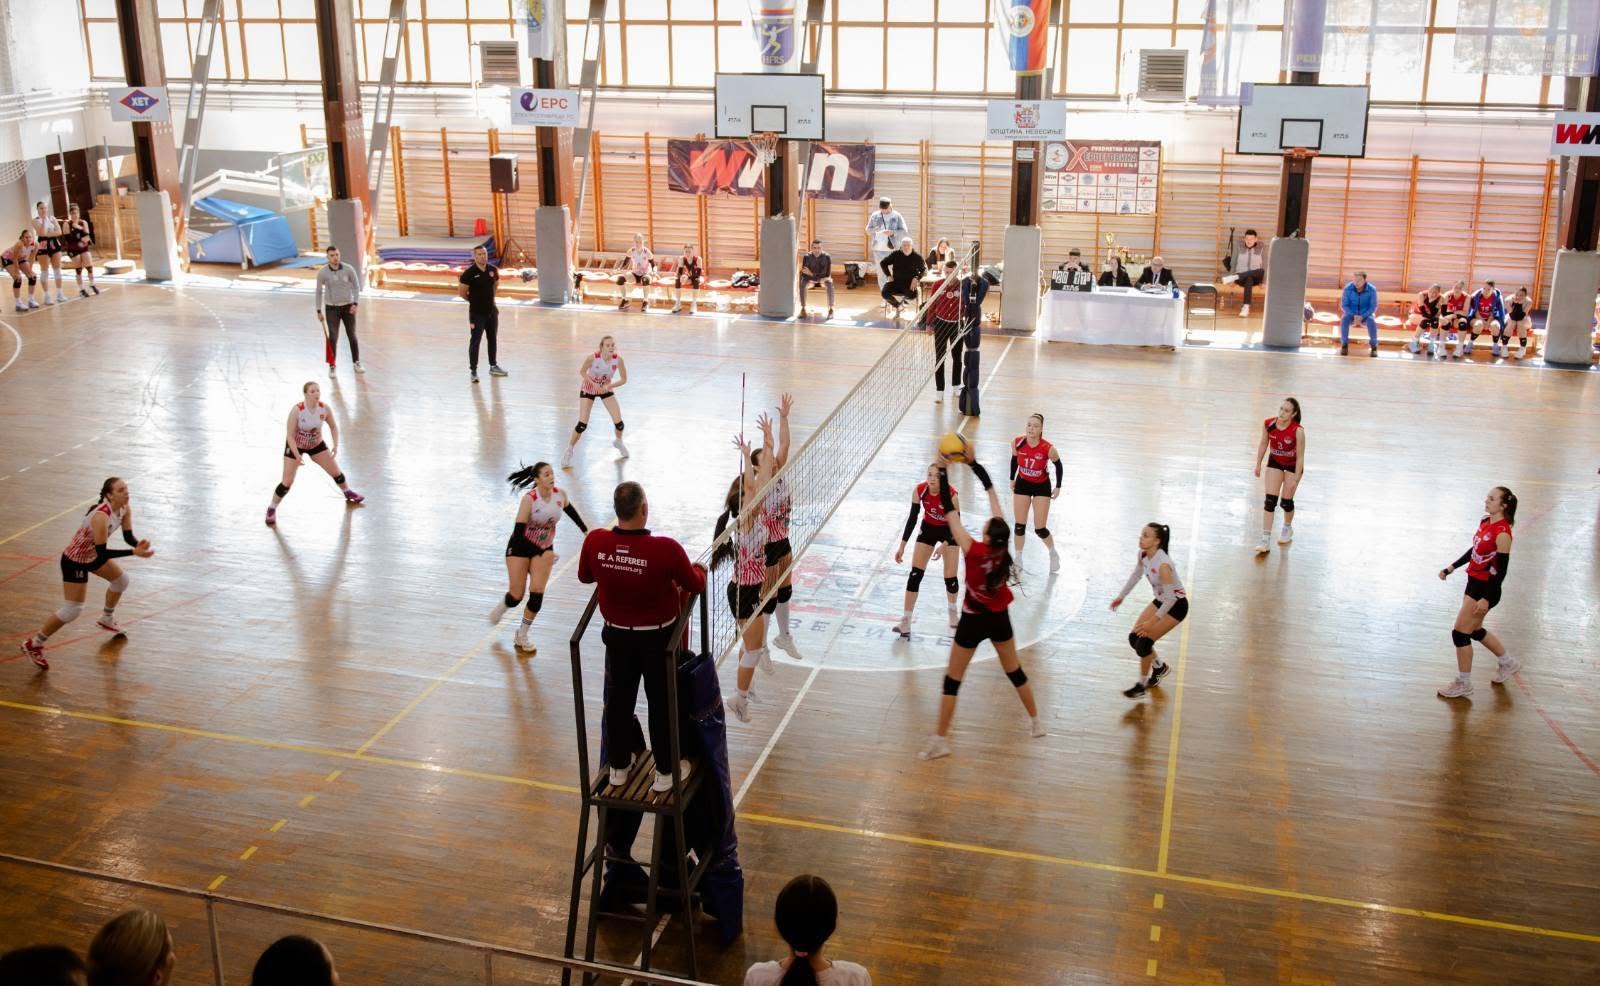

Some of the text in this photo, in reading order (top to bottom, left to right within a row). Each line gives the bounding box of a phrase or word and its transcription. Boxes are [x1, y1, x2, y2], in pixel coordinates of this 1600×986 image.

[1025, 128, 1064, 136] НЕВЕСИЊЕ
[1024, 458, 1036, 469] 17
[597, 552, 648, 568] BE A REFEREE!
